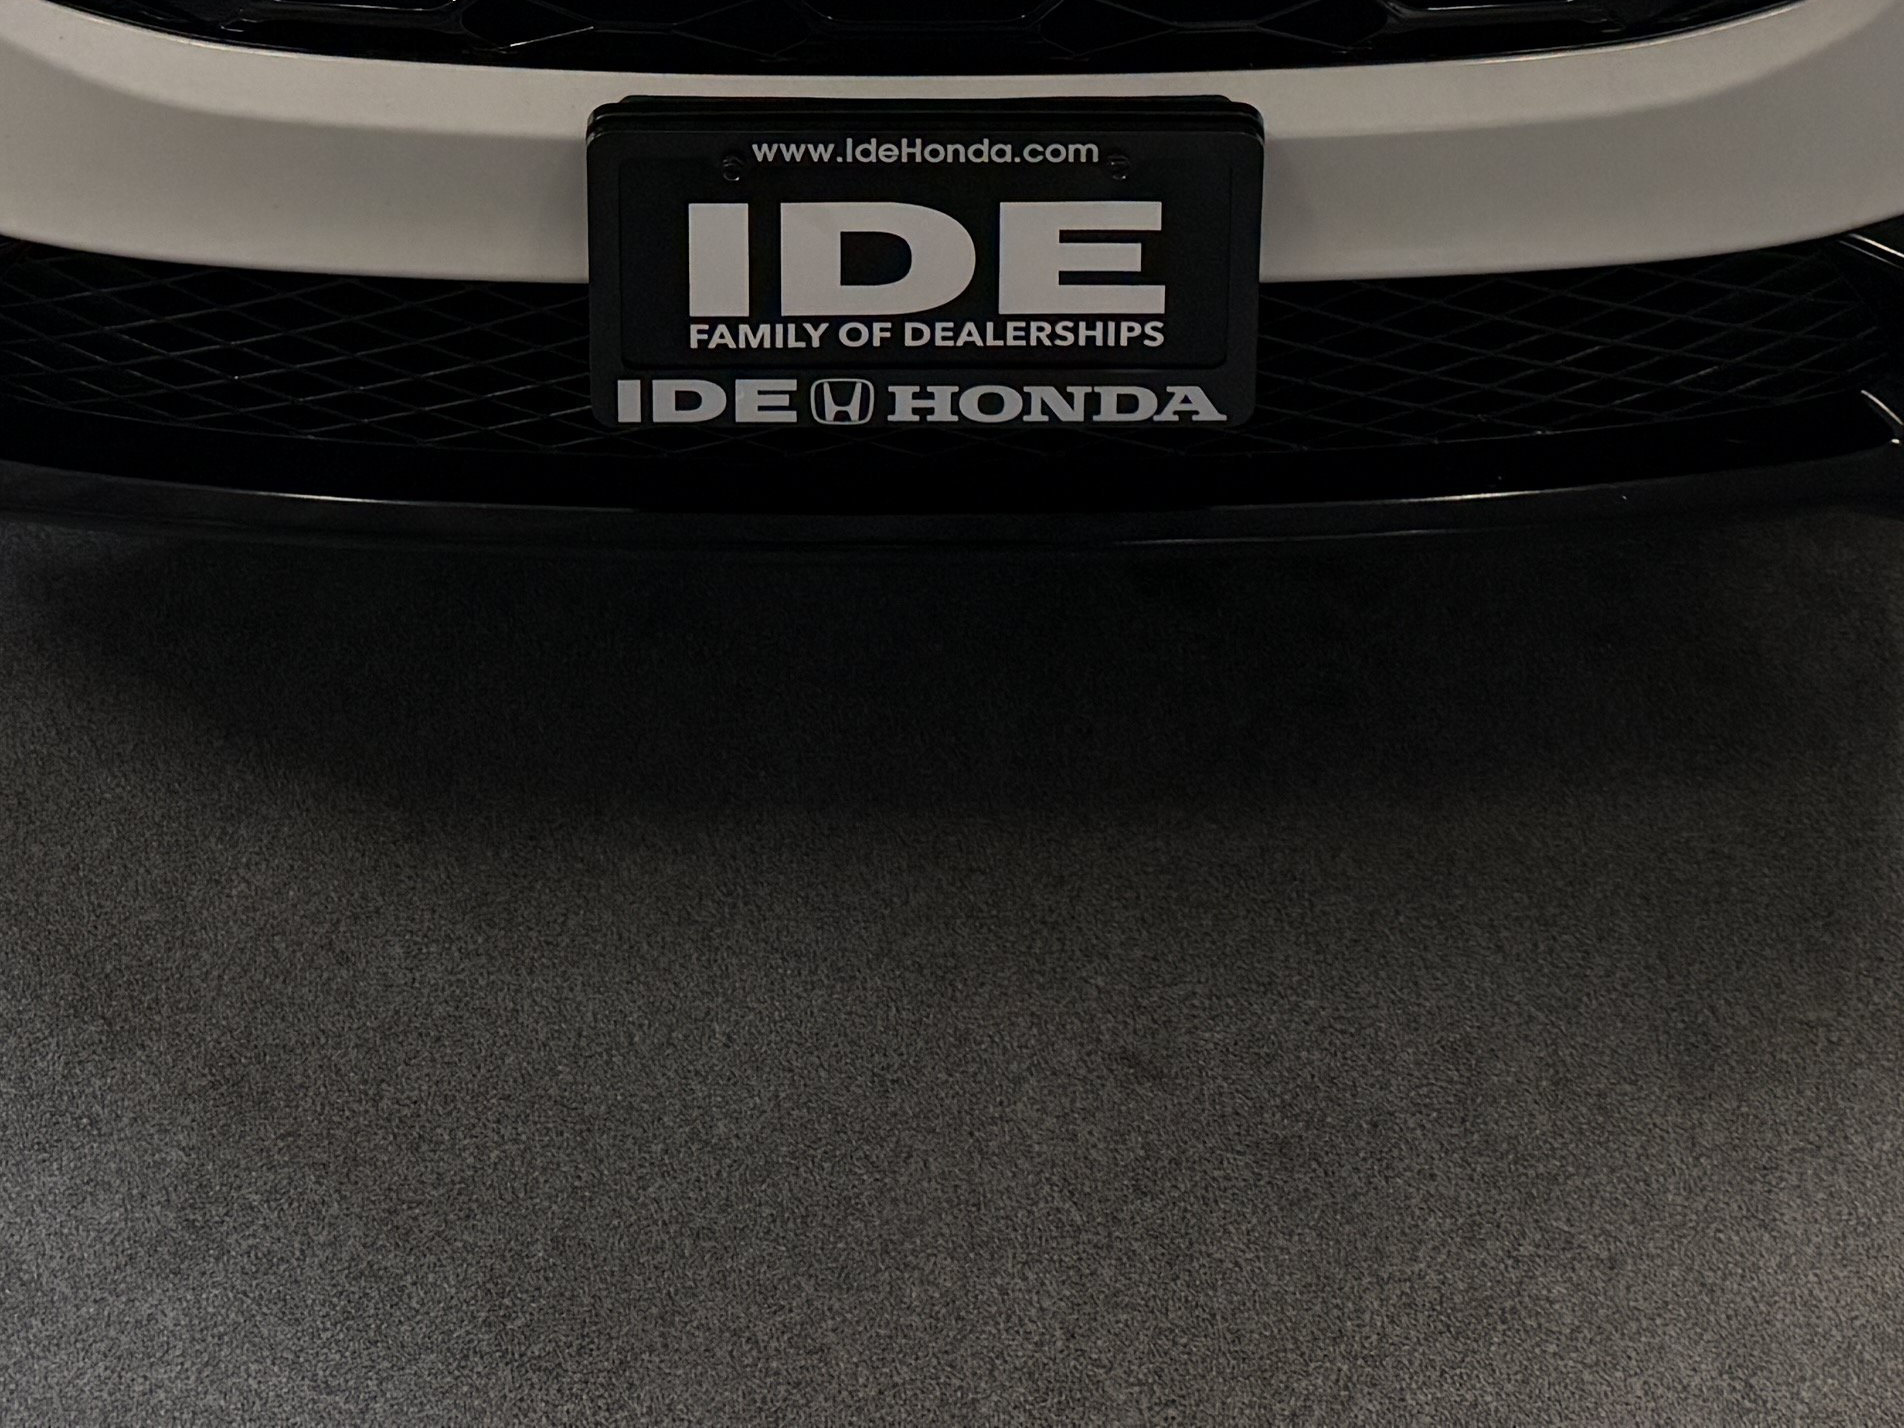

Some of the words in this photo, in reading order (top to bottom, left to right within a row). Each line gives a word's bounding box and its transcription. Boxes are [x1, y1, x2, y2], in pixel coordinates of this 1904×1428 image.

[751, 137, 1100, 165] www.IdeHonda.com
[688, 200, 1167, 318] IDE
[689, 323, 830, 350] FAMILY
[838, 322, 893, 350] OF
[904, 321, 1167, 349] DEALERSHIPS
[616, 379, 799, 425] IDE
[886, 385, 1228, 424] HONDA
